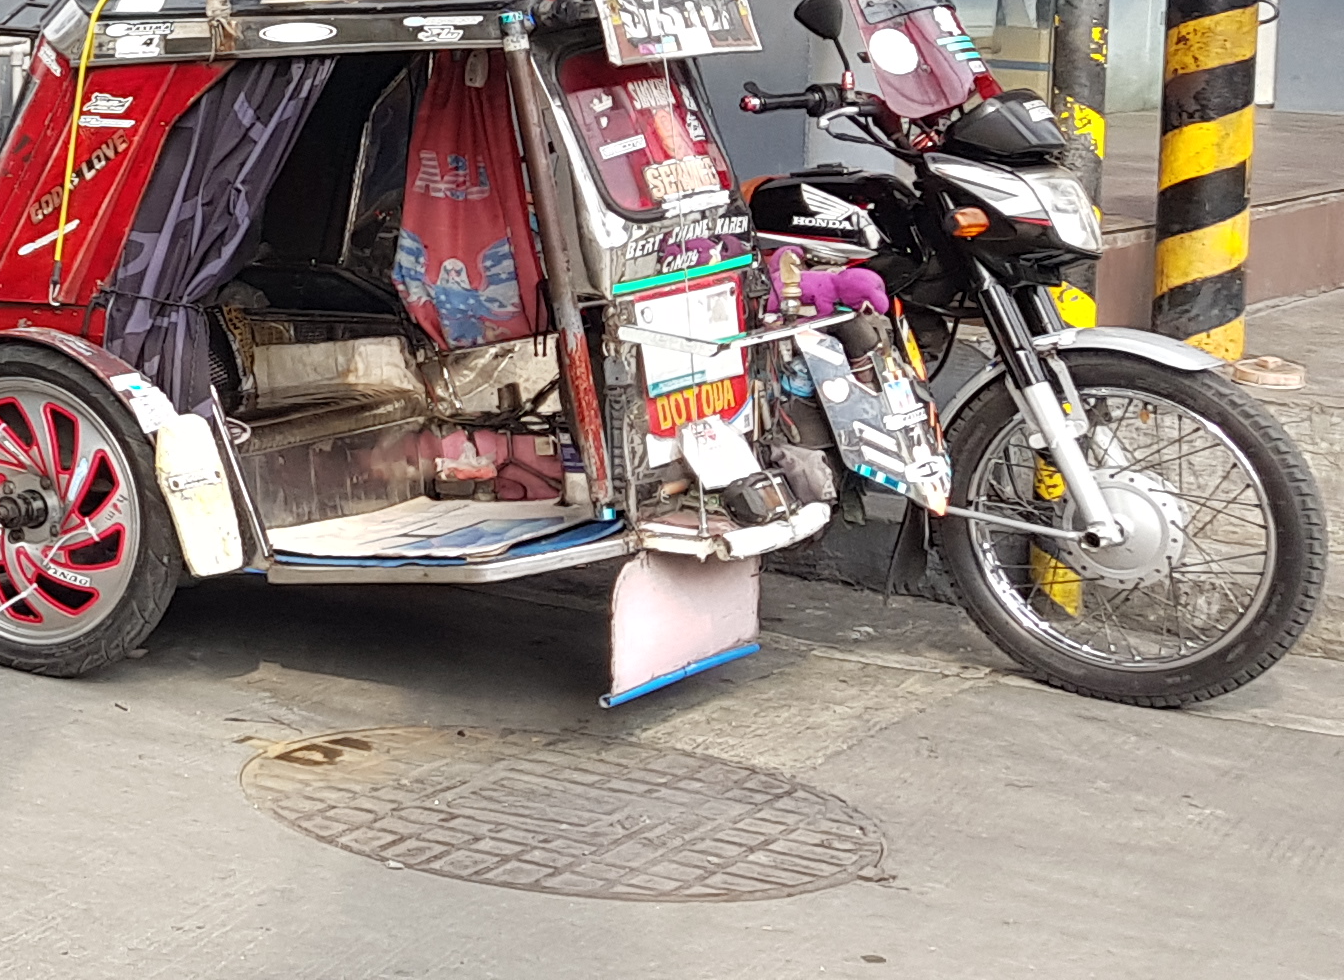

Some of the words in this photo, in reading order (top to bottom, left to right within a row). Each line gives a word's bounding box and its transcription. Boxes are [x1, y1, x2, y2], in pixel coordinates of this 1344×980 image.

[29, 183, 64, 224] GOD
[80, 129, 130, 181] LOVE
[626, 233, 662, 260] BERT
[714, 215, 749, 235] KAREN
[793, 215, 854, 230] HONDA
